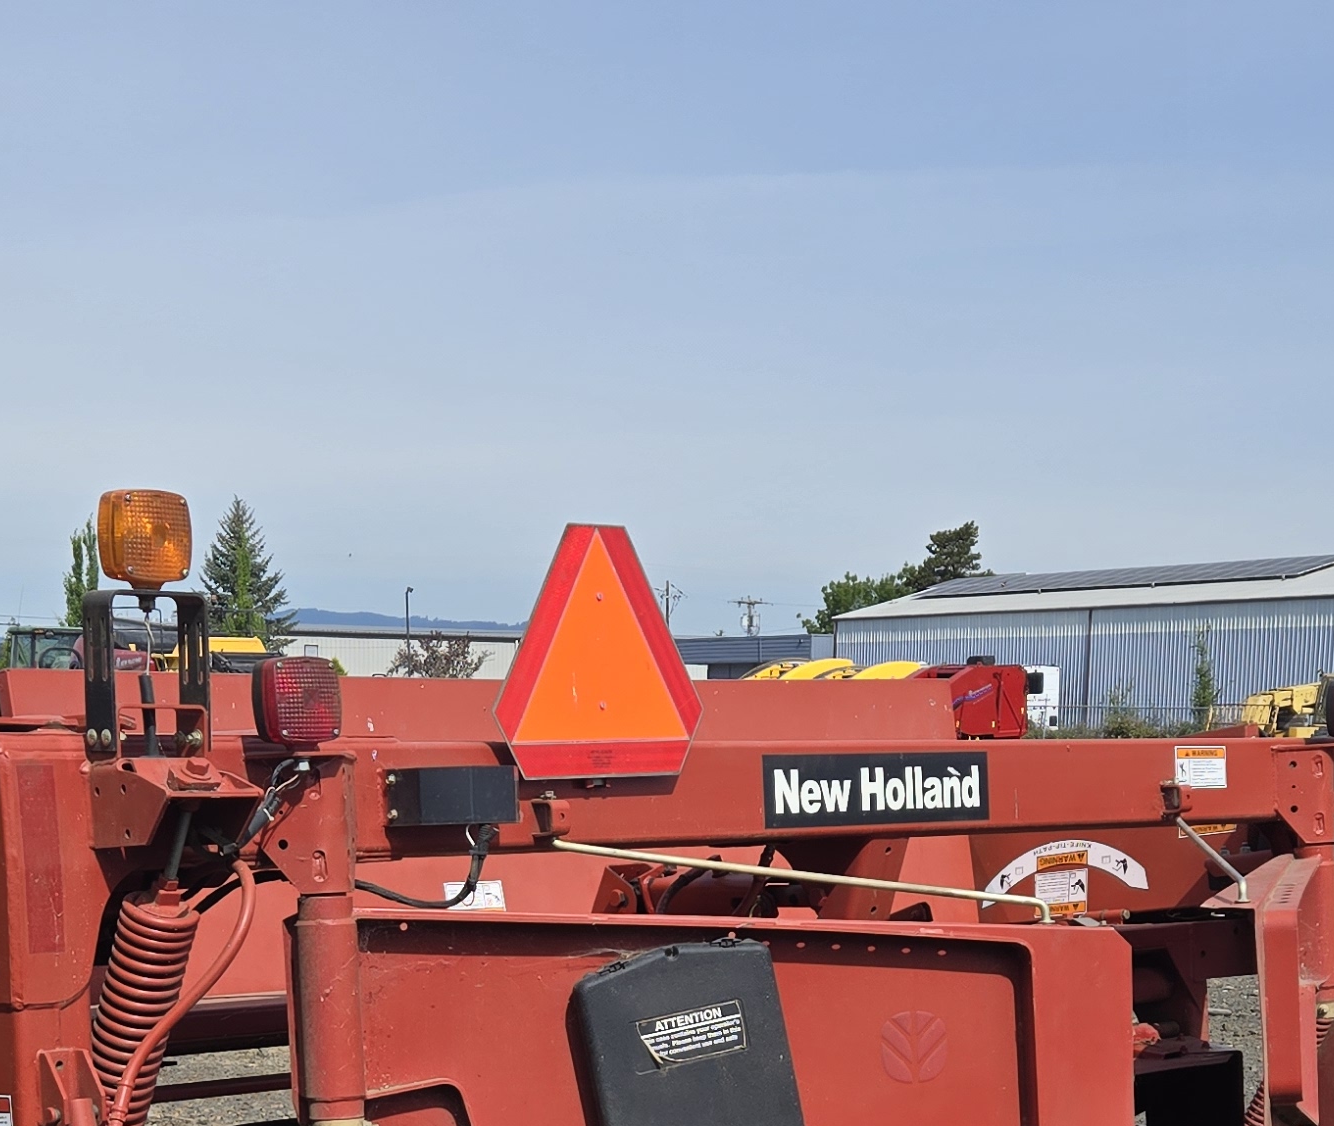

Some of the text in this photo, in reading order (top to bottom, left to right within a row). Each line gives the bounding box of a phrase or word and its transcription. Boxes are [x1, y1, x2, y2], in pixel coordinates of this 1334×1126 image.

[1191, 749, 1218, 757] WARNING
[773, 765, 981, 815] New Holland
[1039, 852, 1076, 866] WARNING
[655, 1007, 722, 1032] ATTENTION
